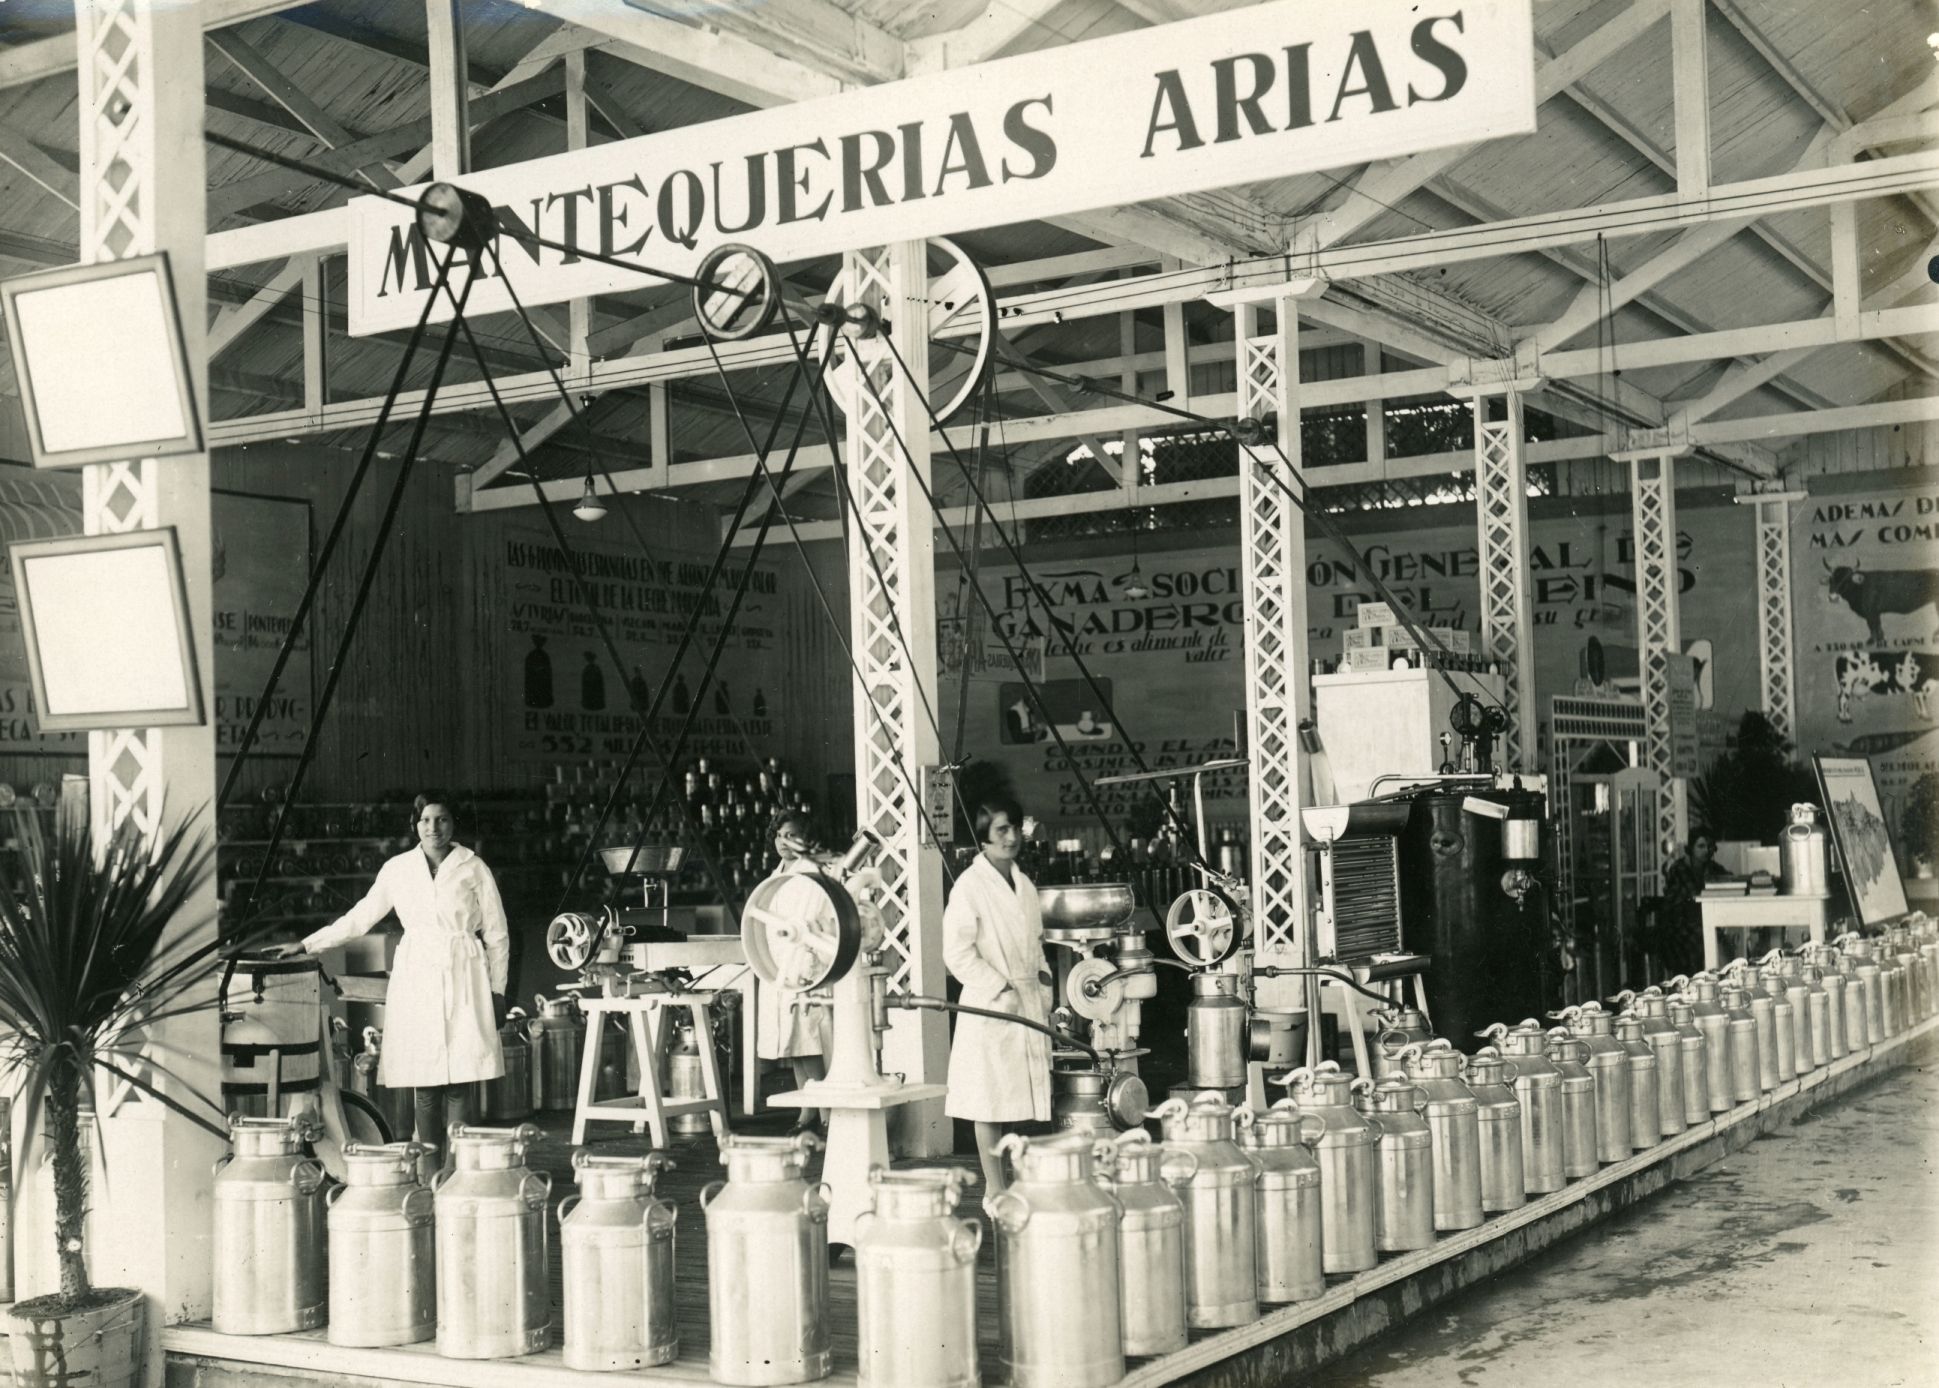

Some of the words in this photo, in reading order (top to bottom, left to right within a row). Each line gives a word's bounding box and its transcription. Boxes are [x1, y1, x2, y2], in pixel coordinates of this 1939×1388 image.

[379, 95, 1055, 297] MANTEQUERIAS
[1140, 10, 1469, 158] ARIAS
[1361, 543, 1593, 583] GENEAL
